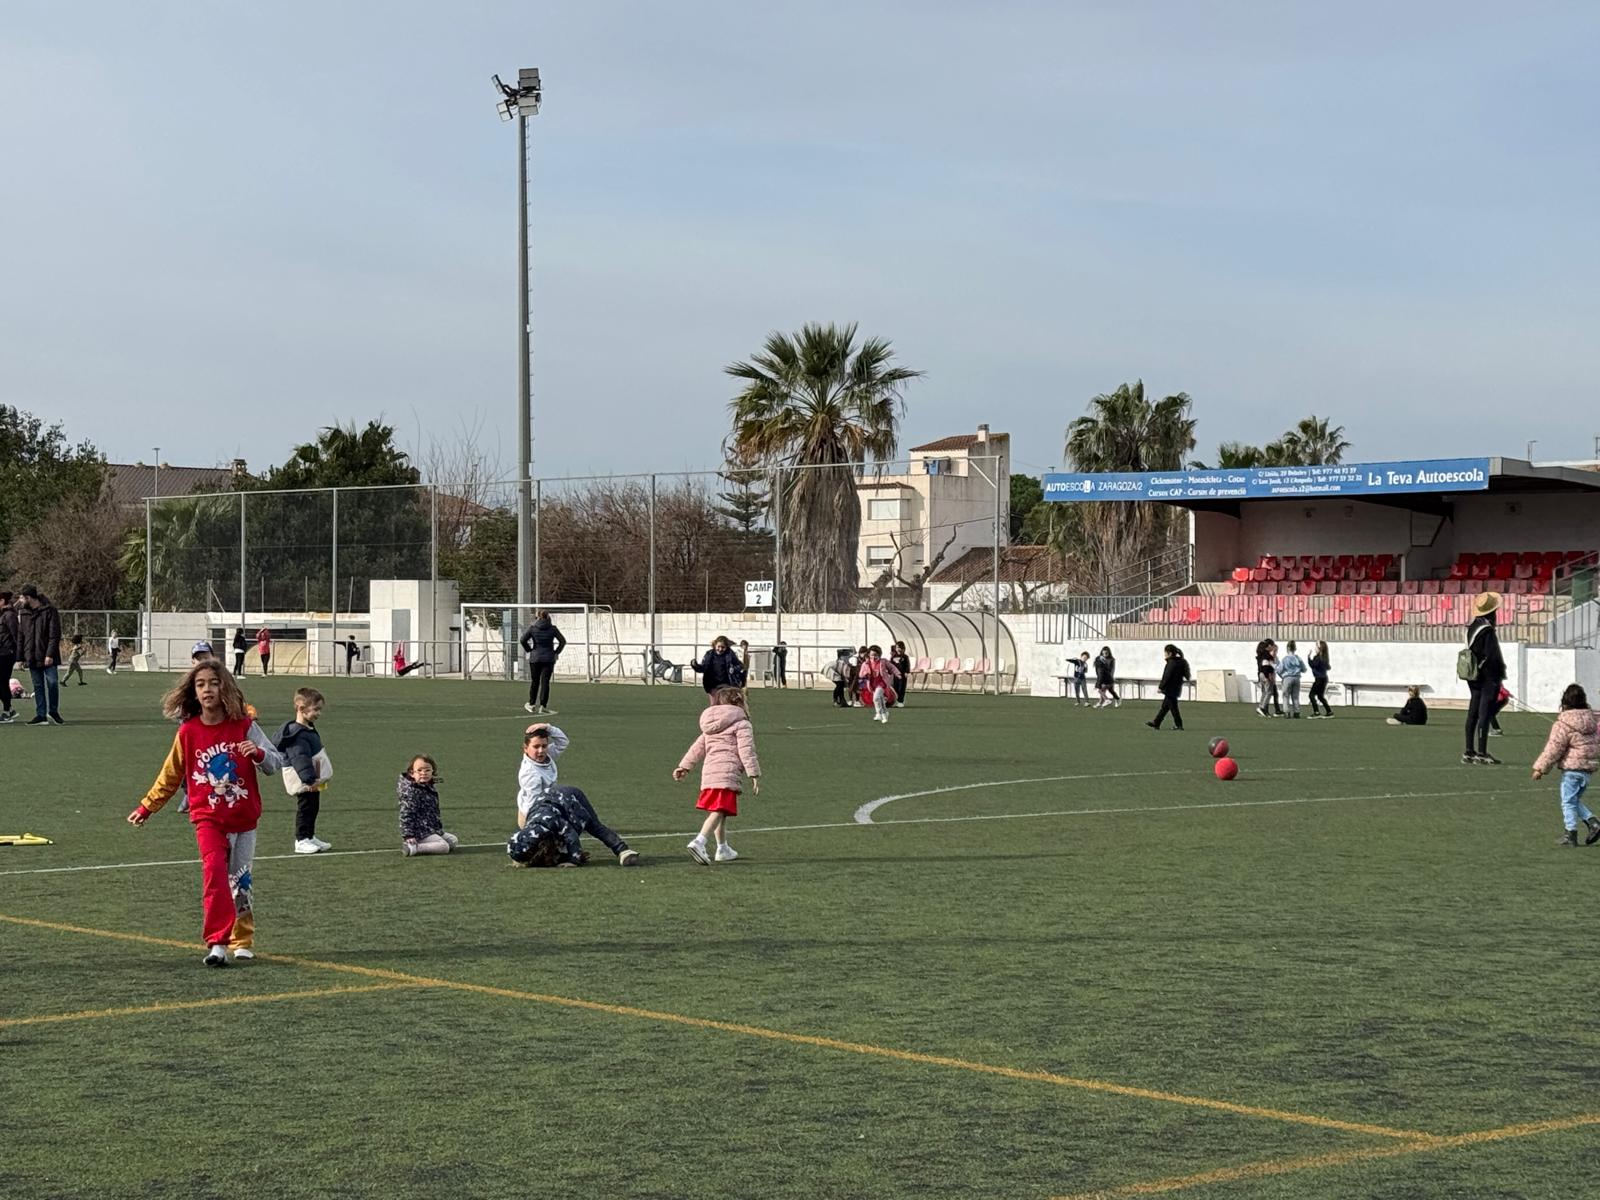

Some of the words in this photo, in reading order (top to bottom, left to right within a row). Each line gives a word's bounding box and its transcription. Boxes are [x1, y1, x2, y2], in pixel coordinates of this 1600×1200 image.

[1368, 472, 1381, 486] La
[1387, 471, 1412, 485] Teva
[1416, 468, 1484, 484] Autoescola
[1046, 480, 1095, 492] AUTOESCOLA
[746, 583, 772, 592] CAMP
[756, 595, 761, 604] 2
